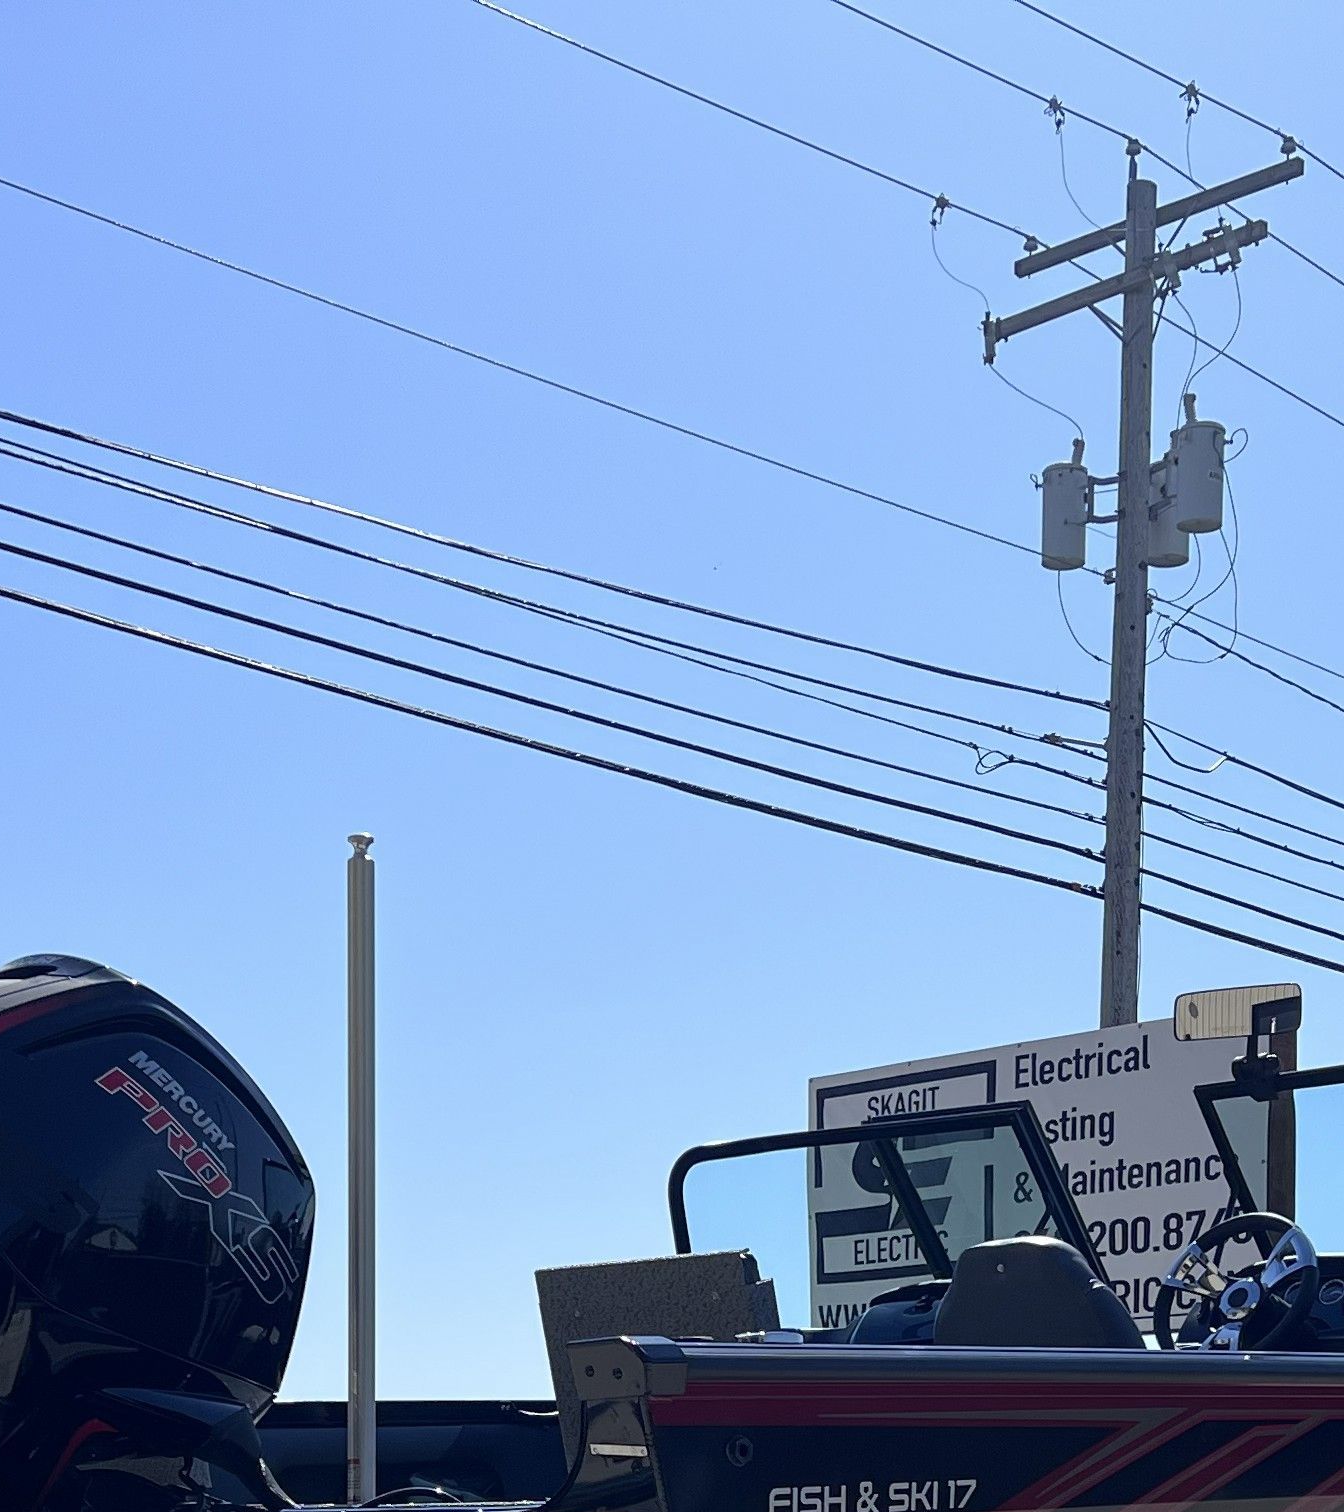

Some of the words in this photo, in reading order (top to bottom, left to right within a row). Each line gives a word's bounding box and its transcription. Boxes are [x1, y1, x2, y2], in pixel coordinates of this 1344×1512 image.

[1014, 1034, 1151, 1089] Electrical
[127, 1050, 236, 1152] MERCURY
[867, 1086, 940, 1117] SKAGIT
[94, 1066, 232, 1199] PRO
[1013, 1171, 1034, 1204] &
[888, 1480, 939, 1512] SKI
[947, 1479, 977, 1509] 17
